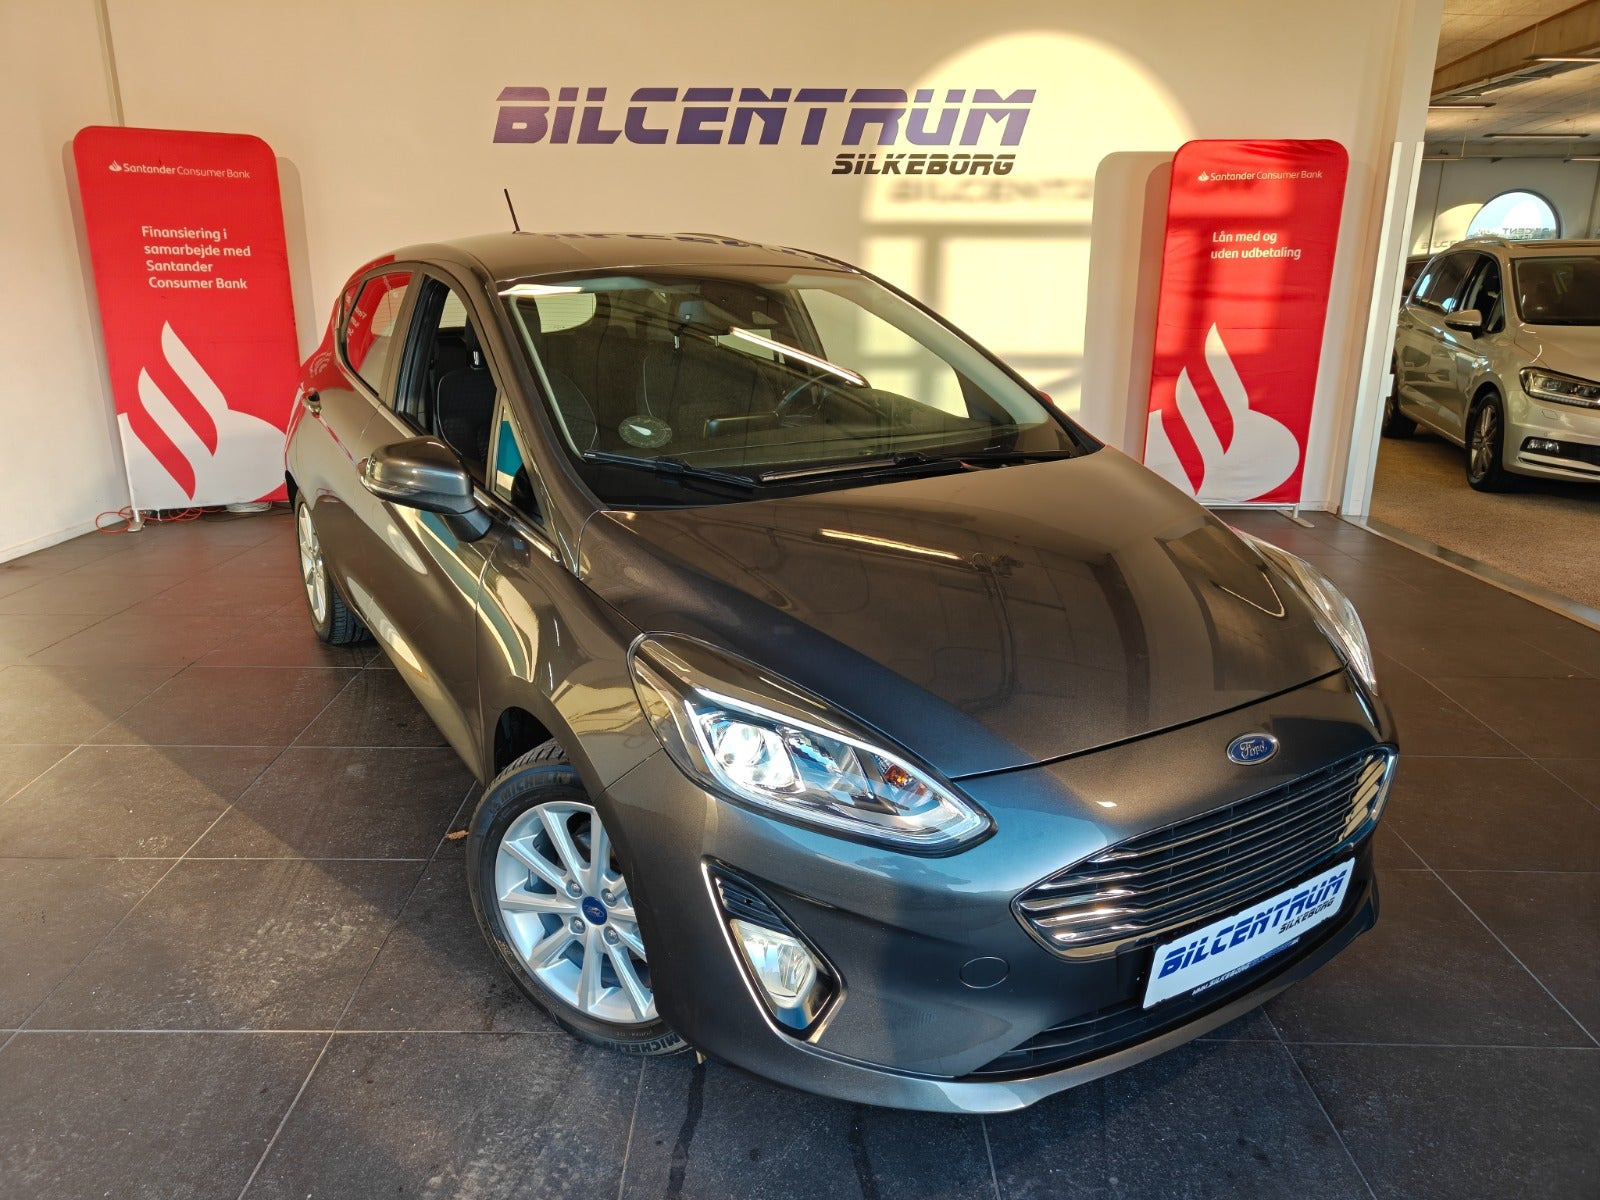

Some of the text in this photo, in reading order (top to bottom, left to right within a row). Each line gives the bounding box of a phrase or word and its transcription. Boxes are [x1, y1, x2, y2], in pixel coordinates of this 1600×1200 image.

[492, 86, 1037, 146] BILCENTRUM
[123, 162, 250, 179] Santander Consumer Bank
[831, 153, 1016, 175] SILKEBORG
[1210, 170, 1323, 181] Santander Consumer Bank
[141, 225, 228, 242] Finansiering i
[1212, 230, 1278, 244] Lån med og
[143, 244, 251, 258] samarbejde med
[1210, 246, 1302, 261] uden udbetaling
[146, 260, 213, 273] Santander
[148, 276, 248, 290] Consumer Bank
[1278, 897, 1336, 935] SILKEBORG
[1158, 869, 1348, 980] BILCENTRUM
